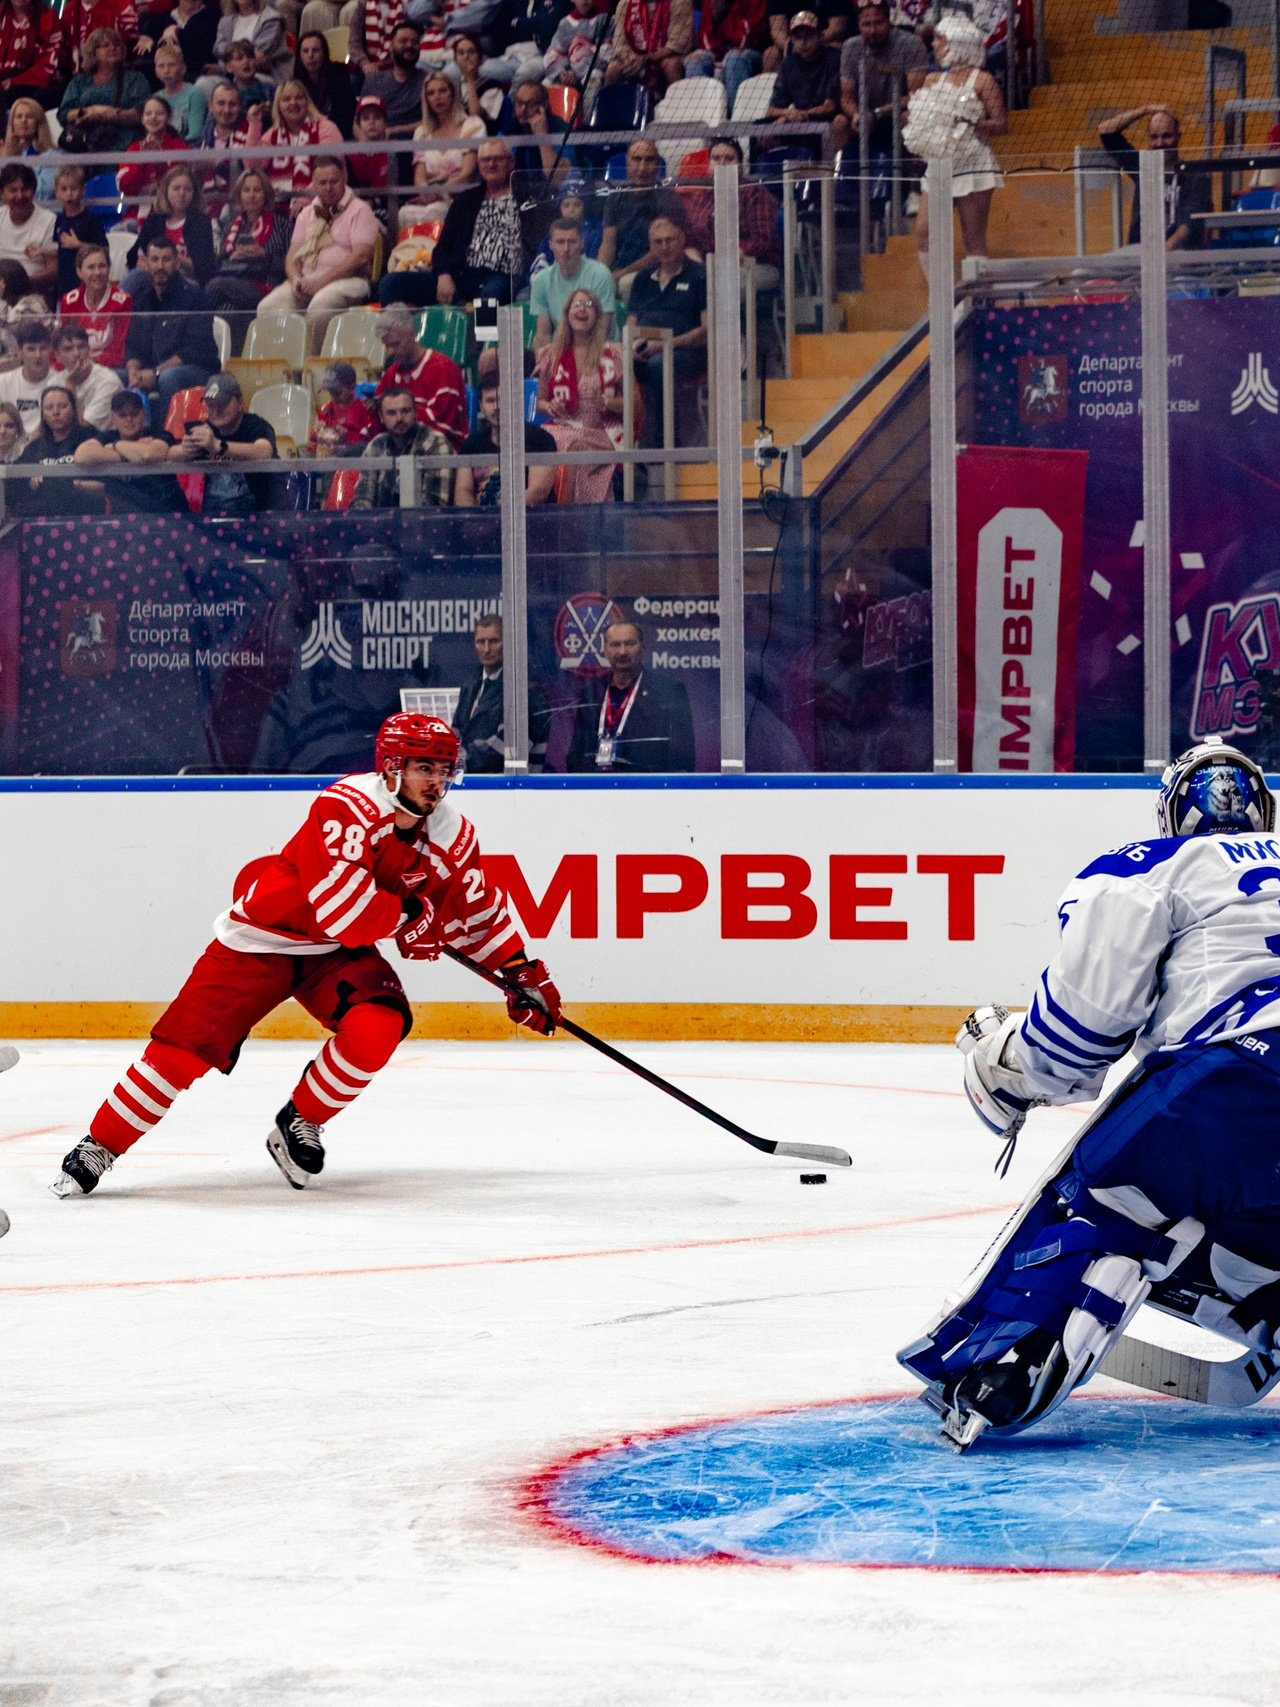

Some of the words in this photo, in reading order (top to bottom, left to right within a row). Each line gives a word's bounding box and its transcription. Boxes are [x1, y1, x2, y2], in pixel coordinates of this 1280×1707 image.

[1078, 354, 1184, 375] Департант
[1079, 379, 1133, 398] спорта
[1079, 402, 1134, 420] города
[129, 600, 246, 621] Департамент
[129, 627, 189, 647] спорта
[563, 633, 605, 653] ФХ
[130, 652, 189, 671] города
[195, 650, 264, 667] Москвы
[363, 635, 432, 670] СПОРТ
[322, 819, 366, 861] 28
[462, 868, 485, 904] 2
